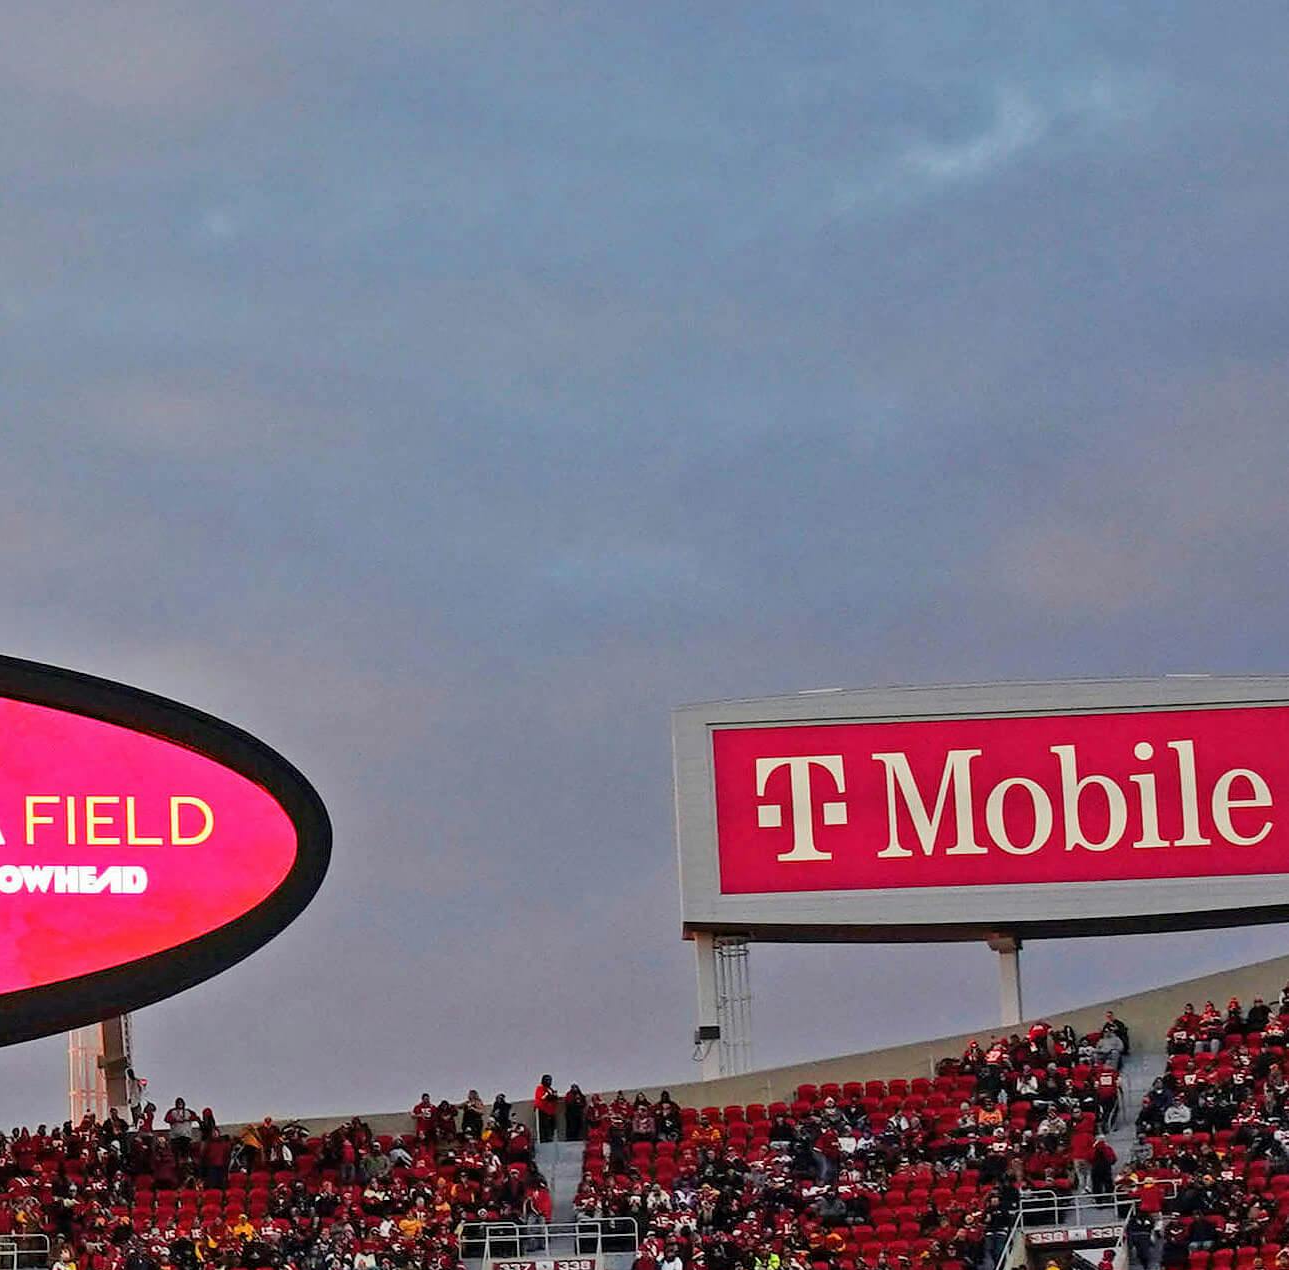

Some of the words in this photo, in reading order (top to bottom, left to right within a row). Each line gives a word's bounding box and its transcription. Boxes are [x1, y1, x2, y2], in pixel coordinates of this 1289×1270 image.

[26, 796, 215, 846] FIELD
[755, 754, 848, 862] T
[872, 740, 1274, 859] Mobile
